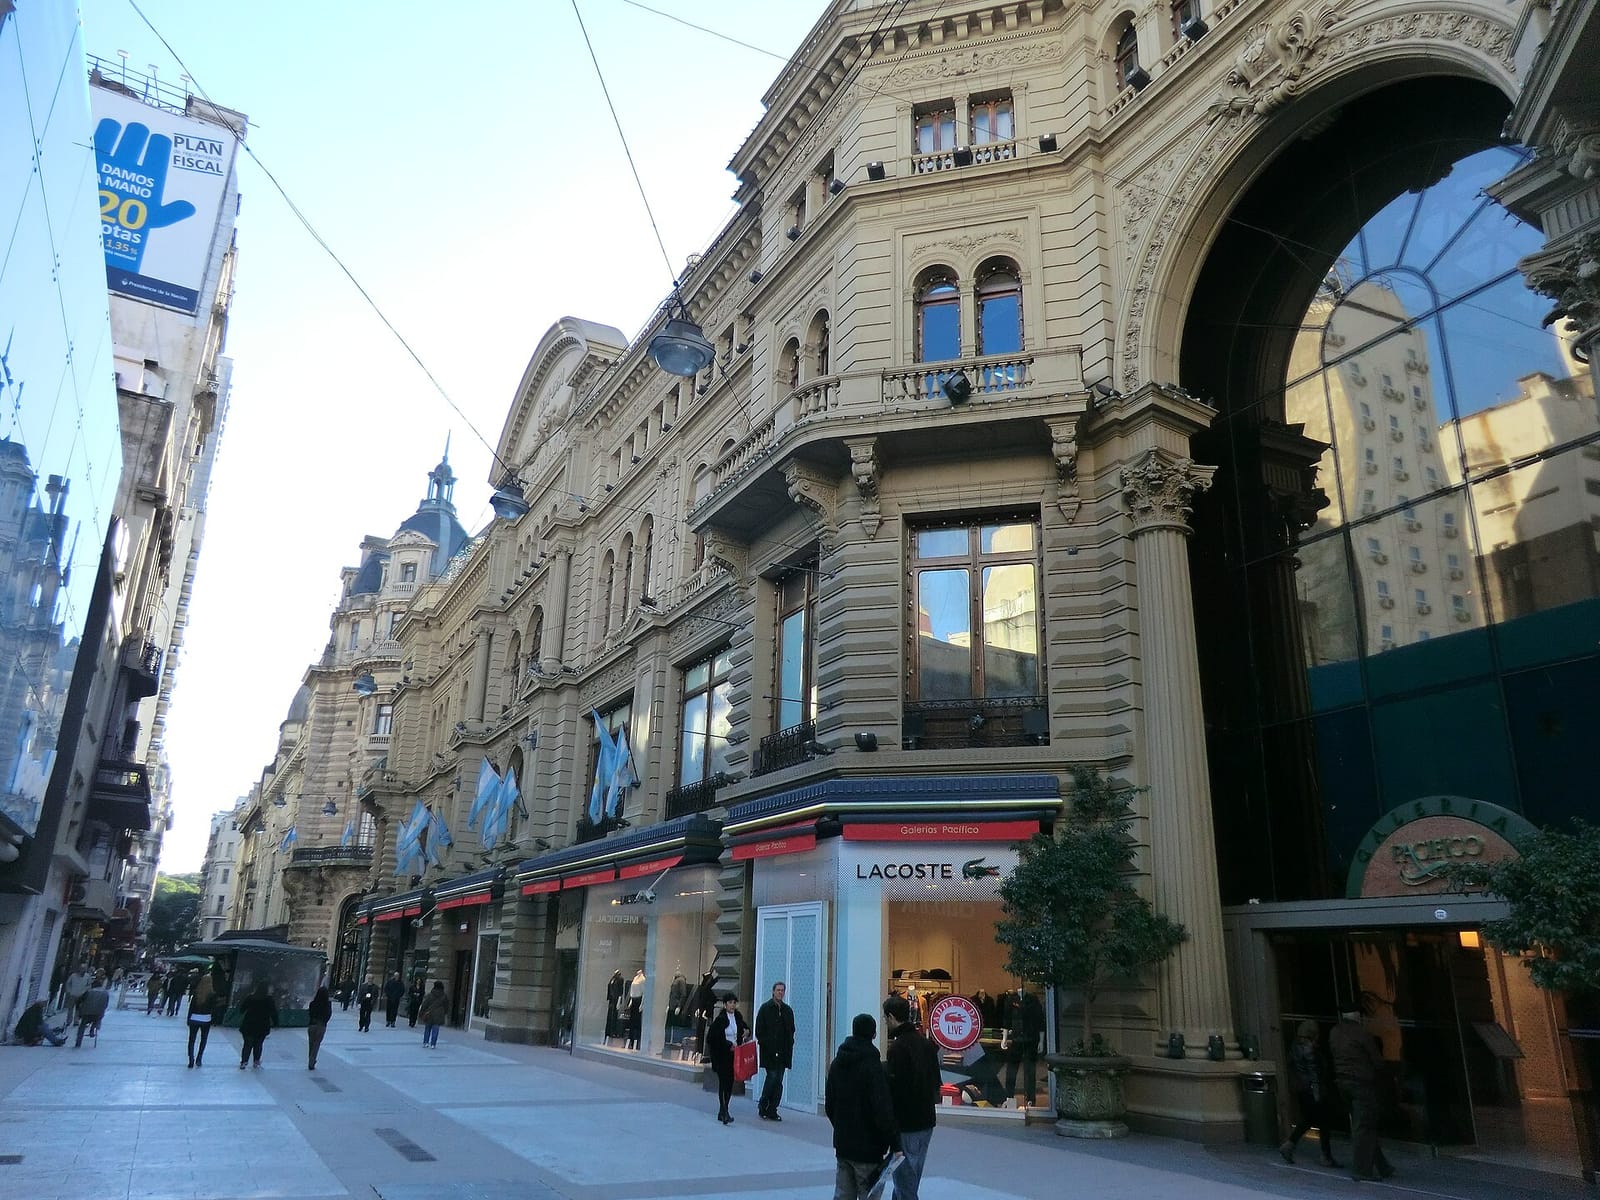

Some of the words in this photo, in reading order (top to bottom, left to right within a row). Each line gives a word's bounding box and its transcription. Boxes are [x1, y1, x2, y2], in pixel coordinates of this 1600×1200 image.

[174, 136, 222, 156] PLAN
[173, 155, 224, 174] FISCAL
[101, 163, 155, 188] DAMOS
[105, 177, 152, 199] MANO
[98, 190, 148, 230] 20
[102, 224, 142, 244] otas
[1358, 797, 1508, 860] GALERIA
[856, 863, 953, 880] LACOSTE
